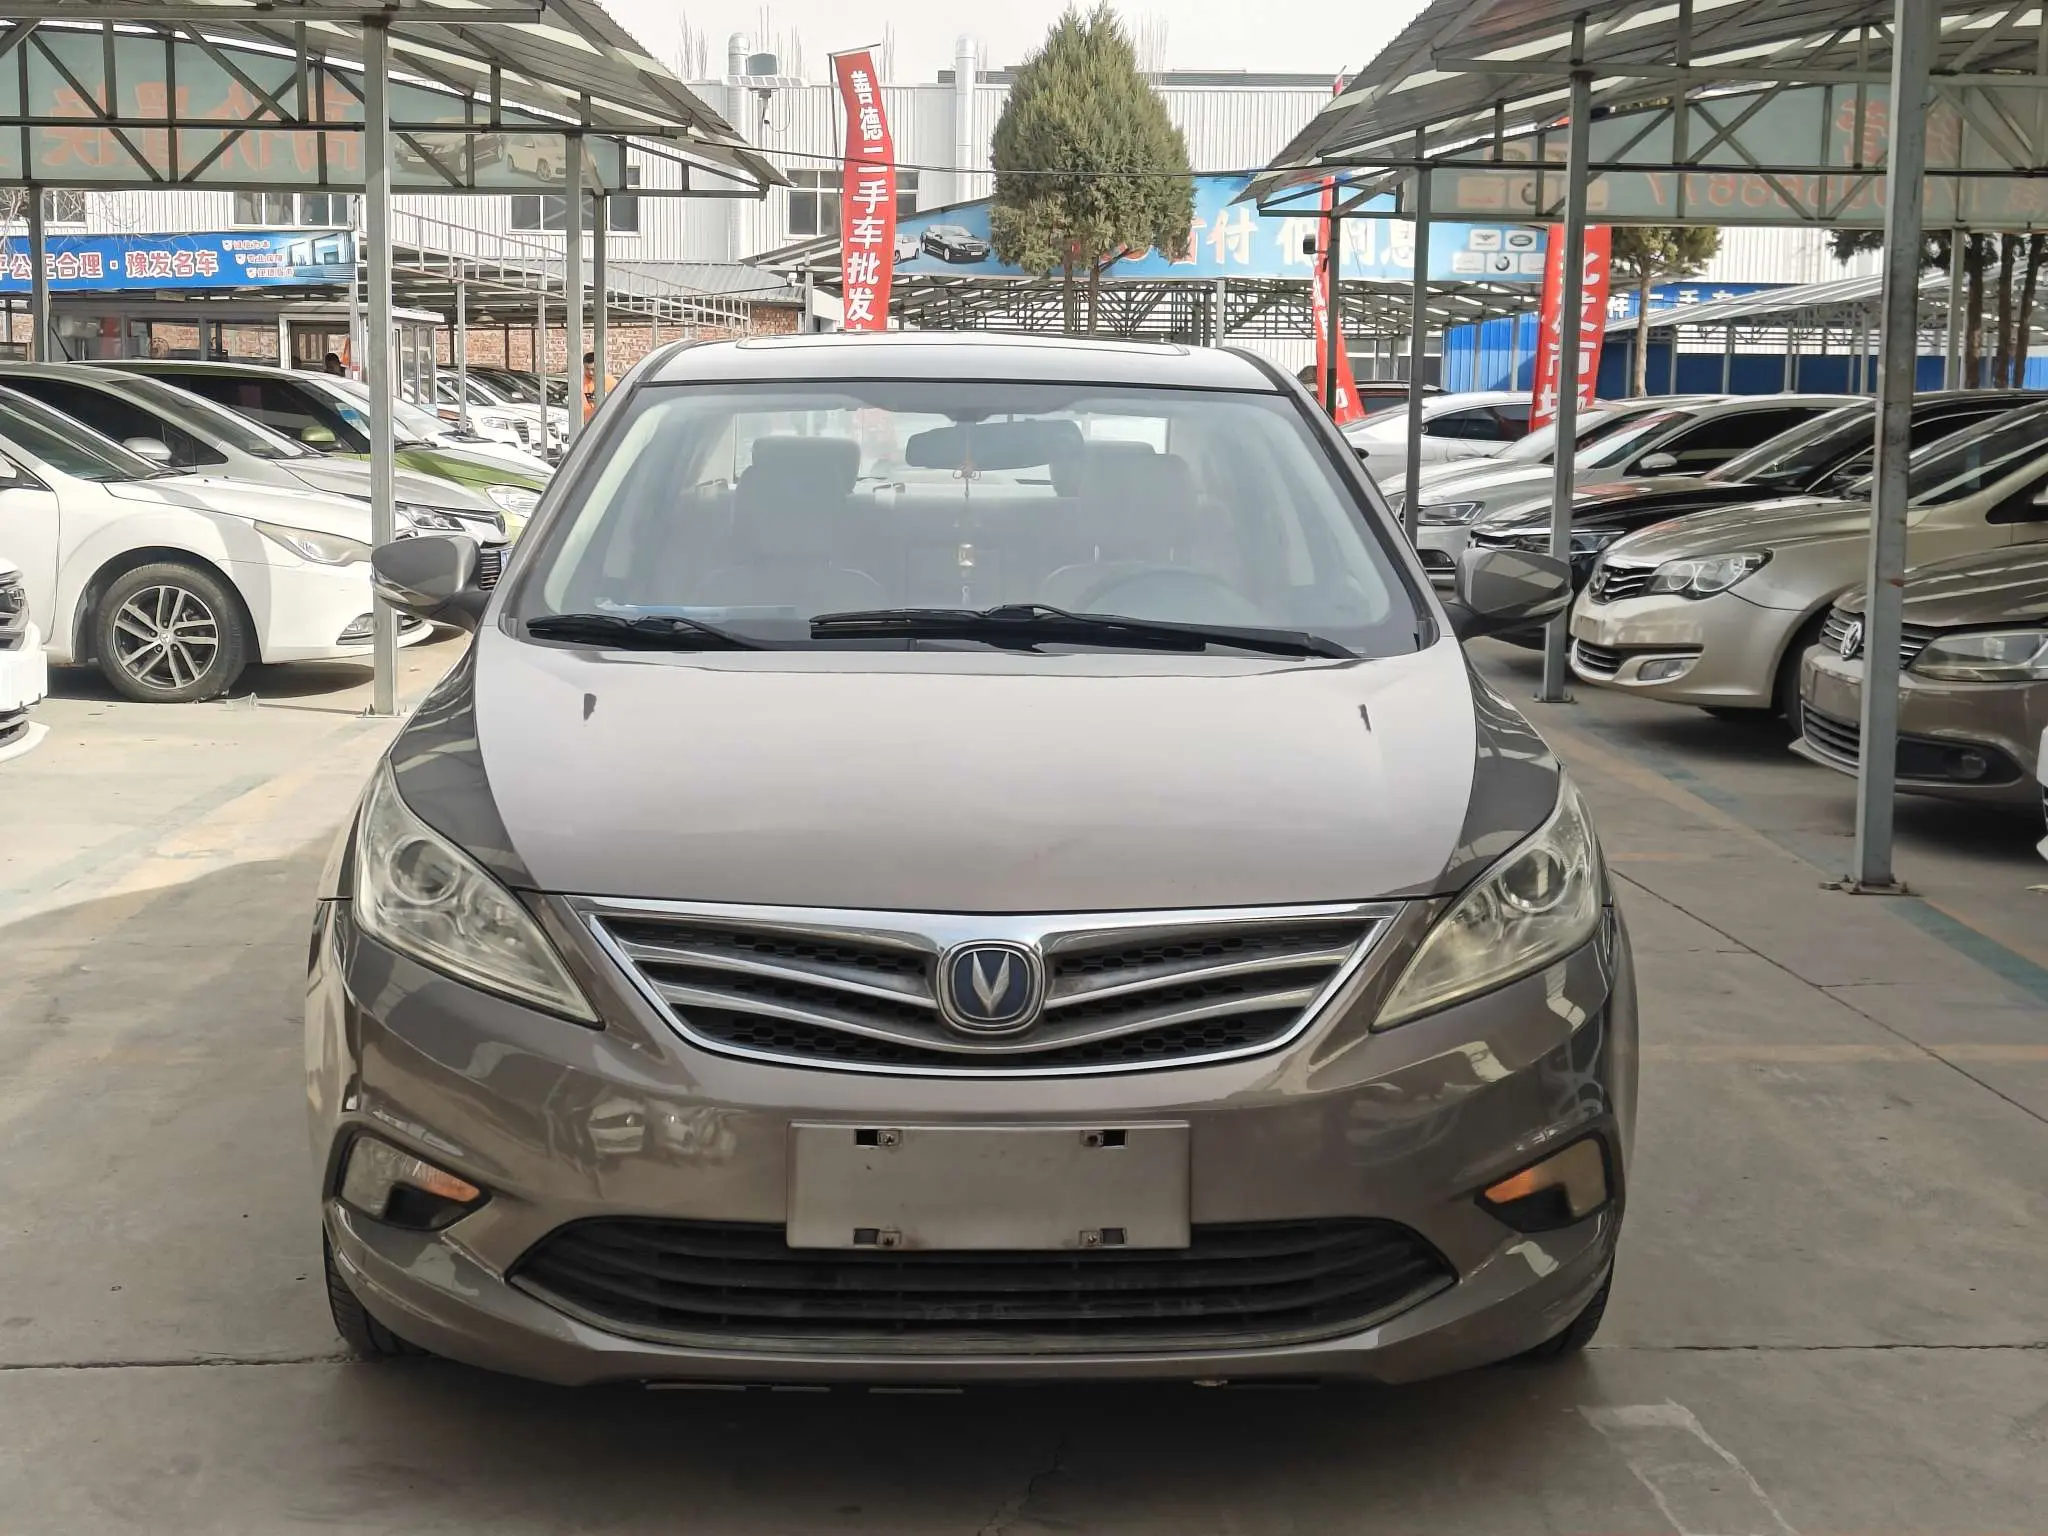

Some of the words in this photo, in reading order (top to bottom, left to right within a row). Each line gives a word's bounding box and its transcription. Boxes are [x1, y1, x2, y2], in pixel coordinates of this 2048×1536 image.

[847, 70, 888, 330] 善德二手车批发
